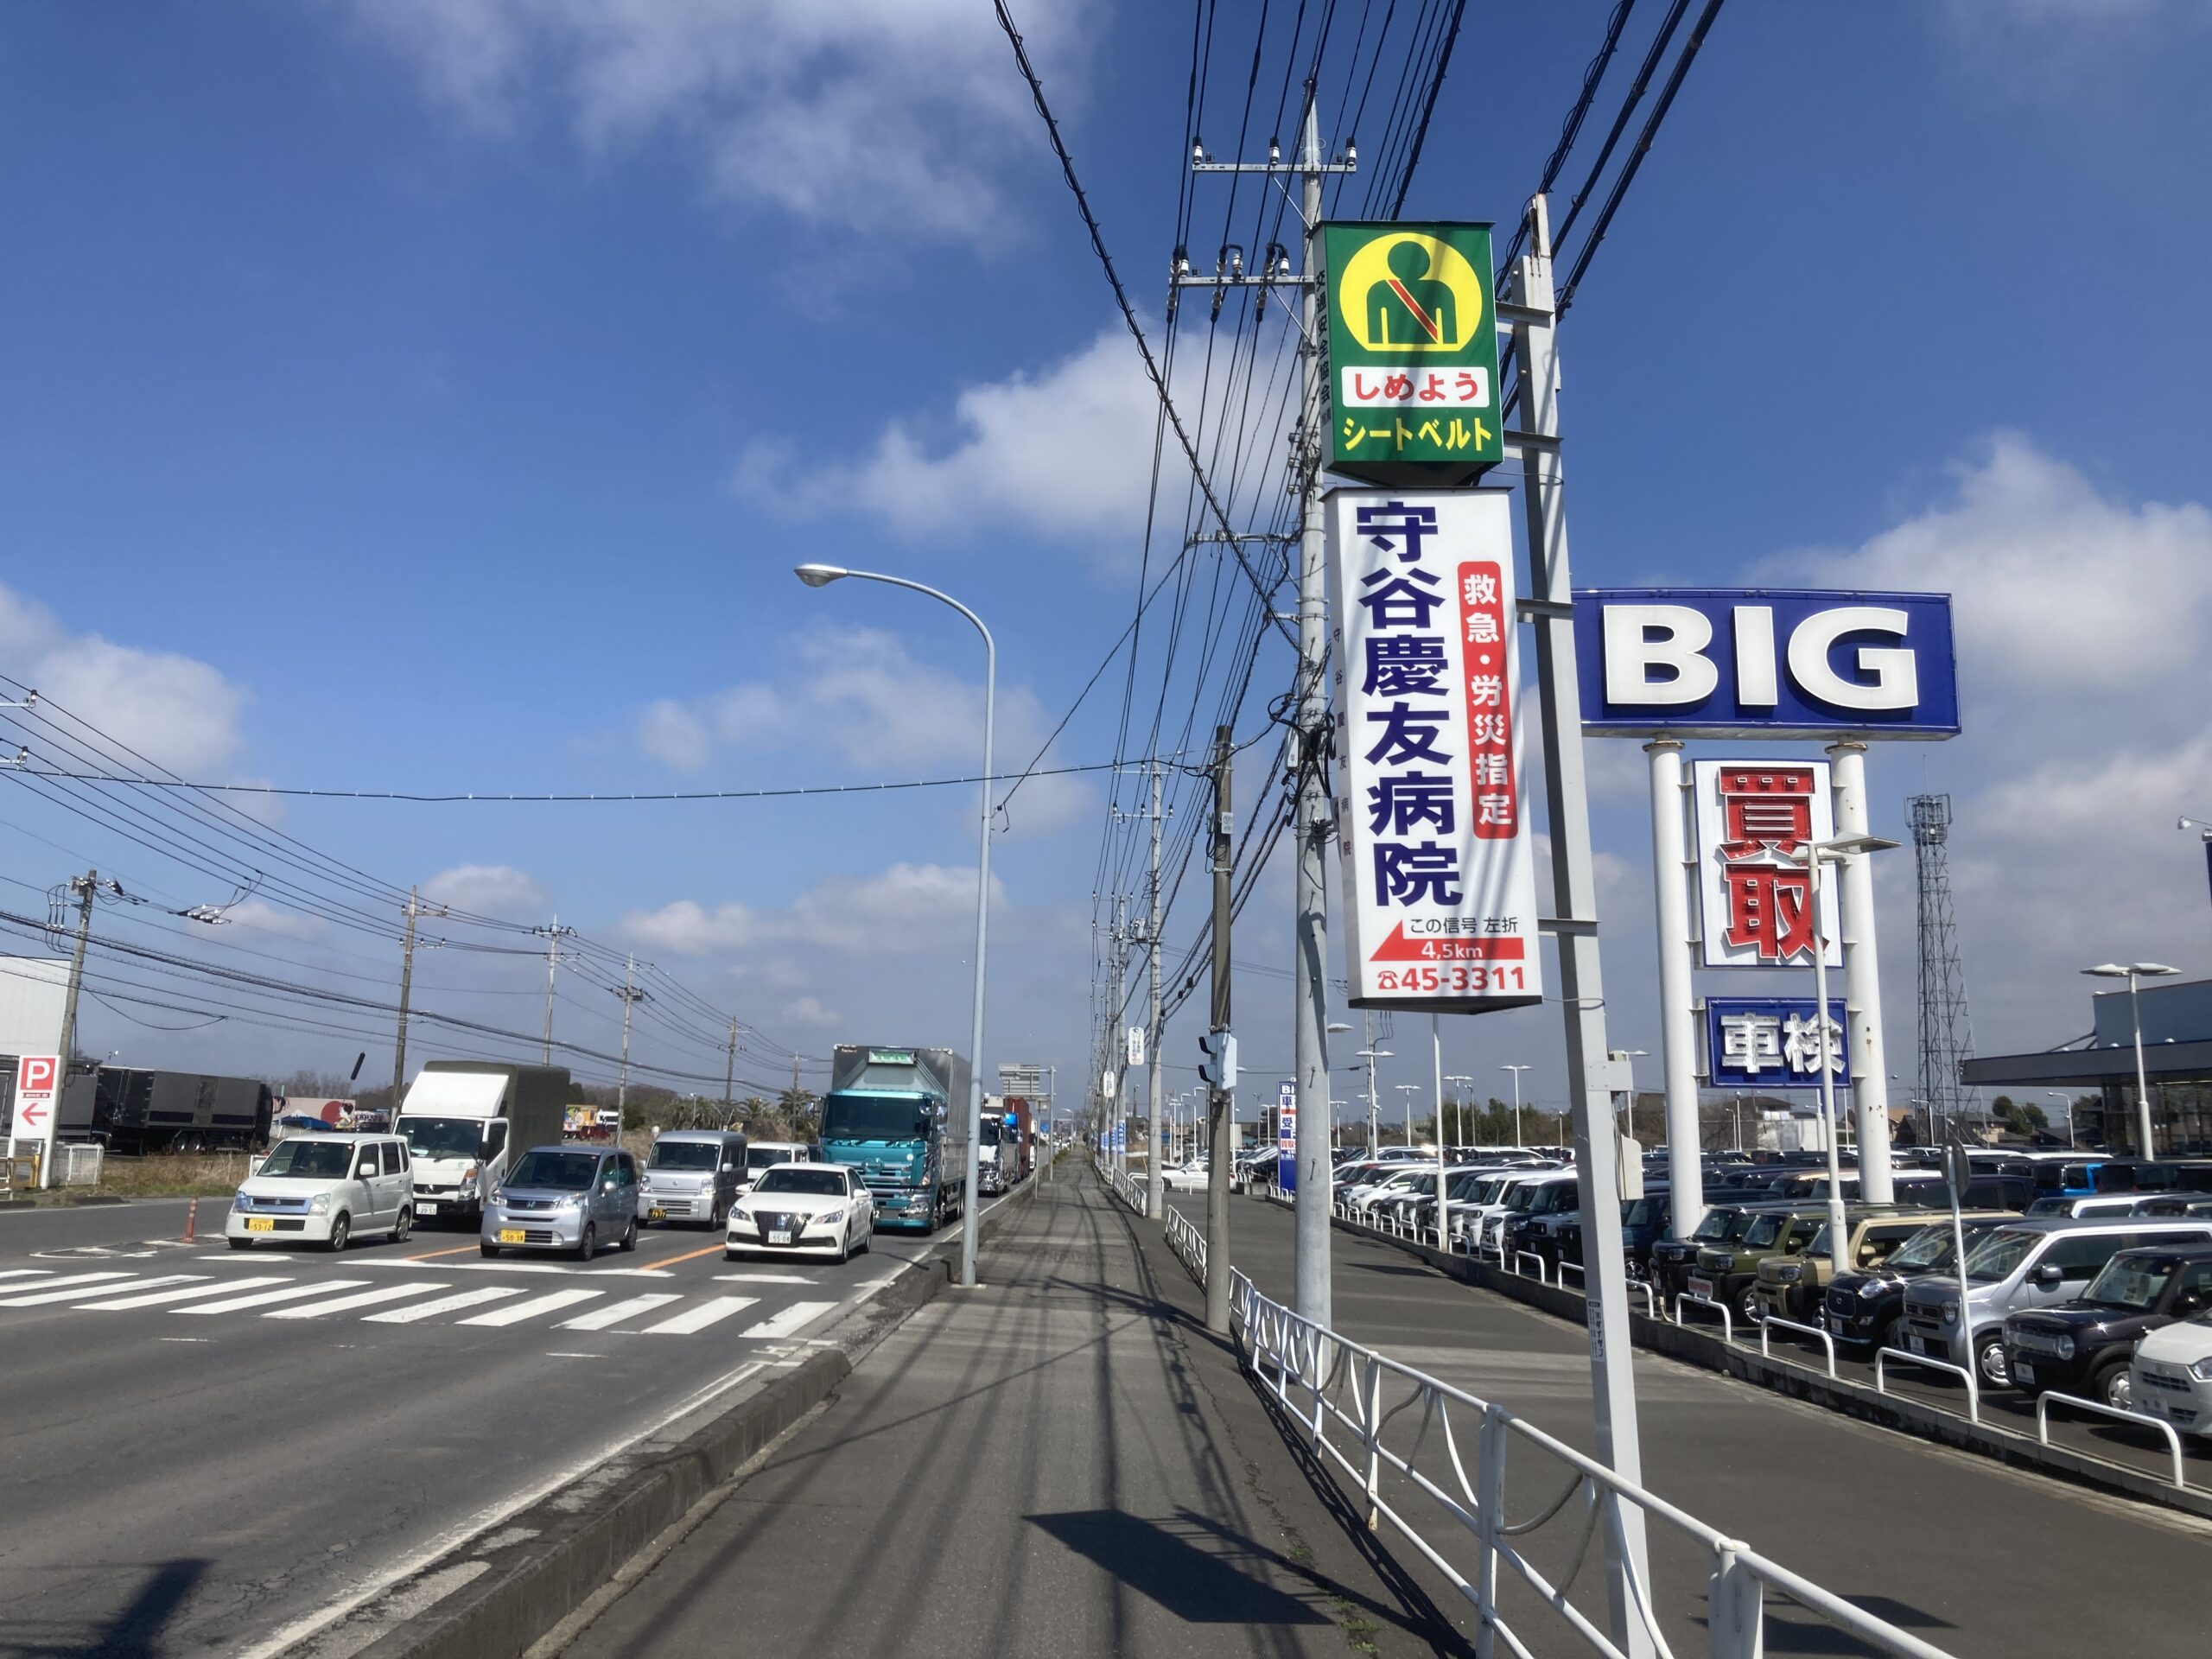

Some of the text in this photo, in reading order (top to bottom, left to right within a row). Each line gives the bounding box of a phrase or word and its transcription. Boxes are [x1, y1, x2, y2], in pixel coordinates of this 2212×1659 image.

[1355, 372, 1478, 401] しめよう
[1343, 417, 1492, 452] シートベルト
[1603, 605, 1918, 710] BIG
[1356, 501, 1464, 907] 守谷慶友病院
[1463, 574, 1512, 826] 救急・労災指定
[1719, 766, 1829, 959] 買取
[1410, 916, 1518, 934] この信号 左折
[1401, 966, 1525, 991] 45-3311
[1721, 1012, 1846, 1074] 車検
[26, 1060, 51, 1089] P
[1281, 1084, 1296, 1095] BI
